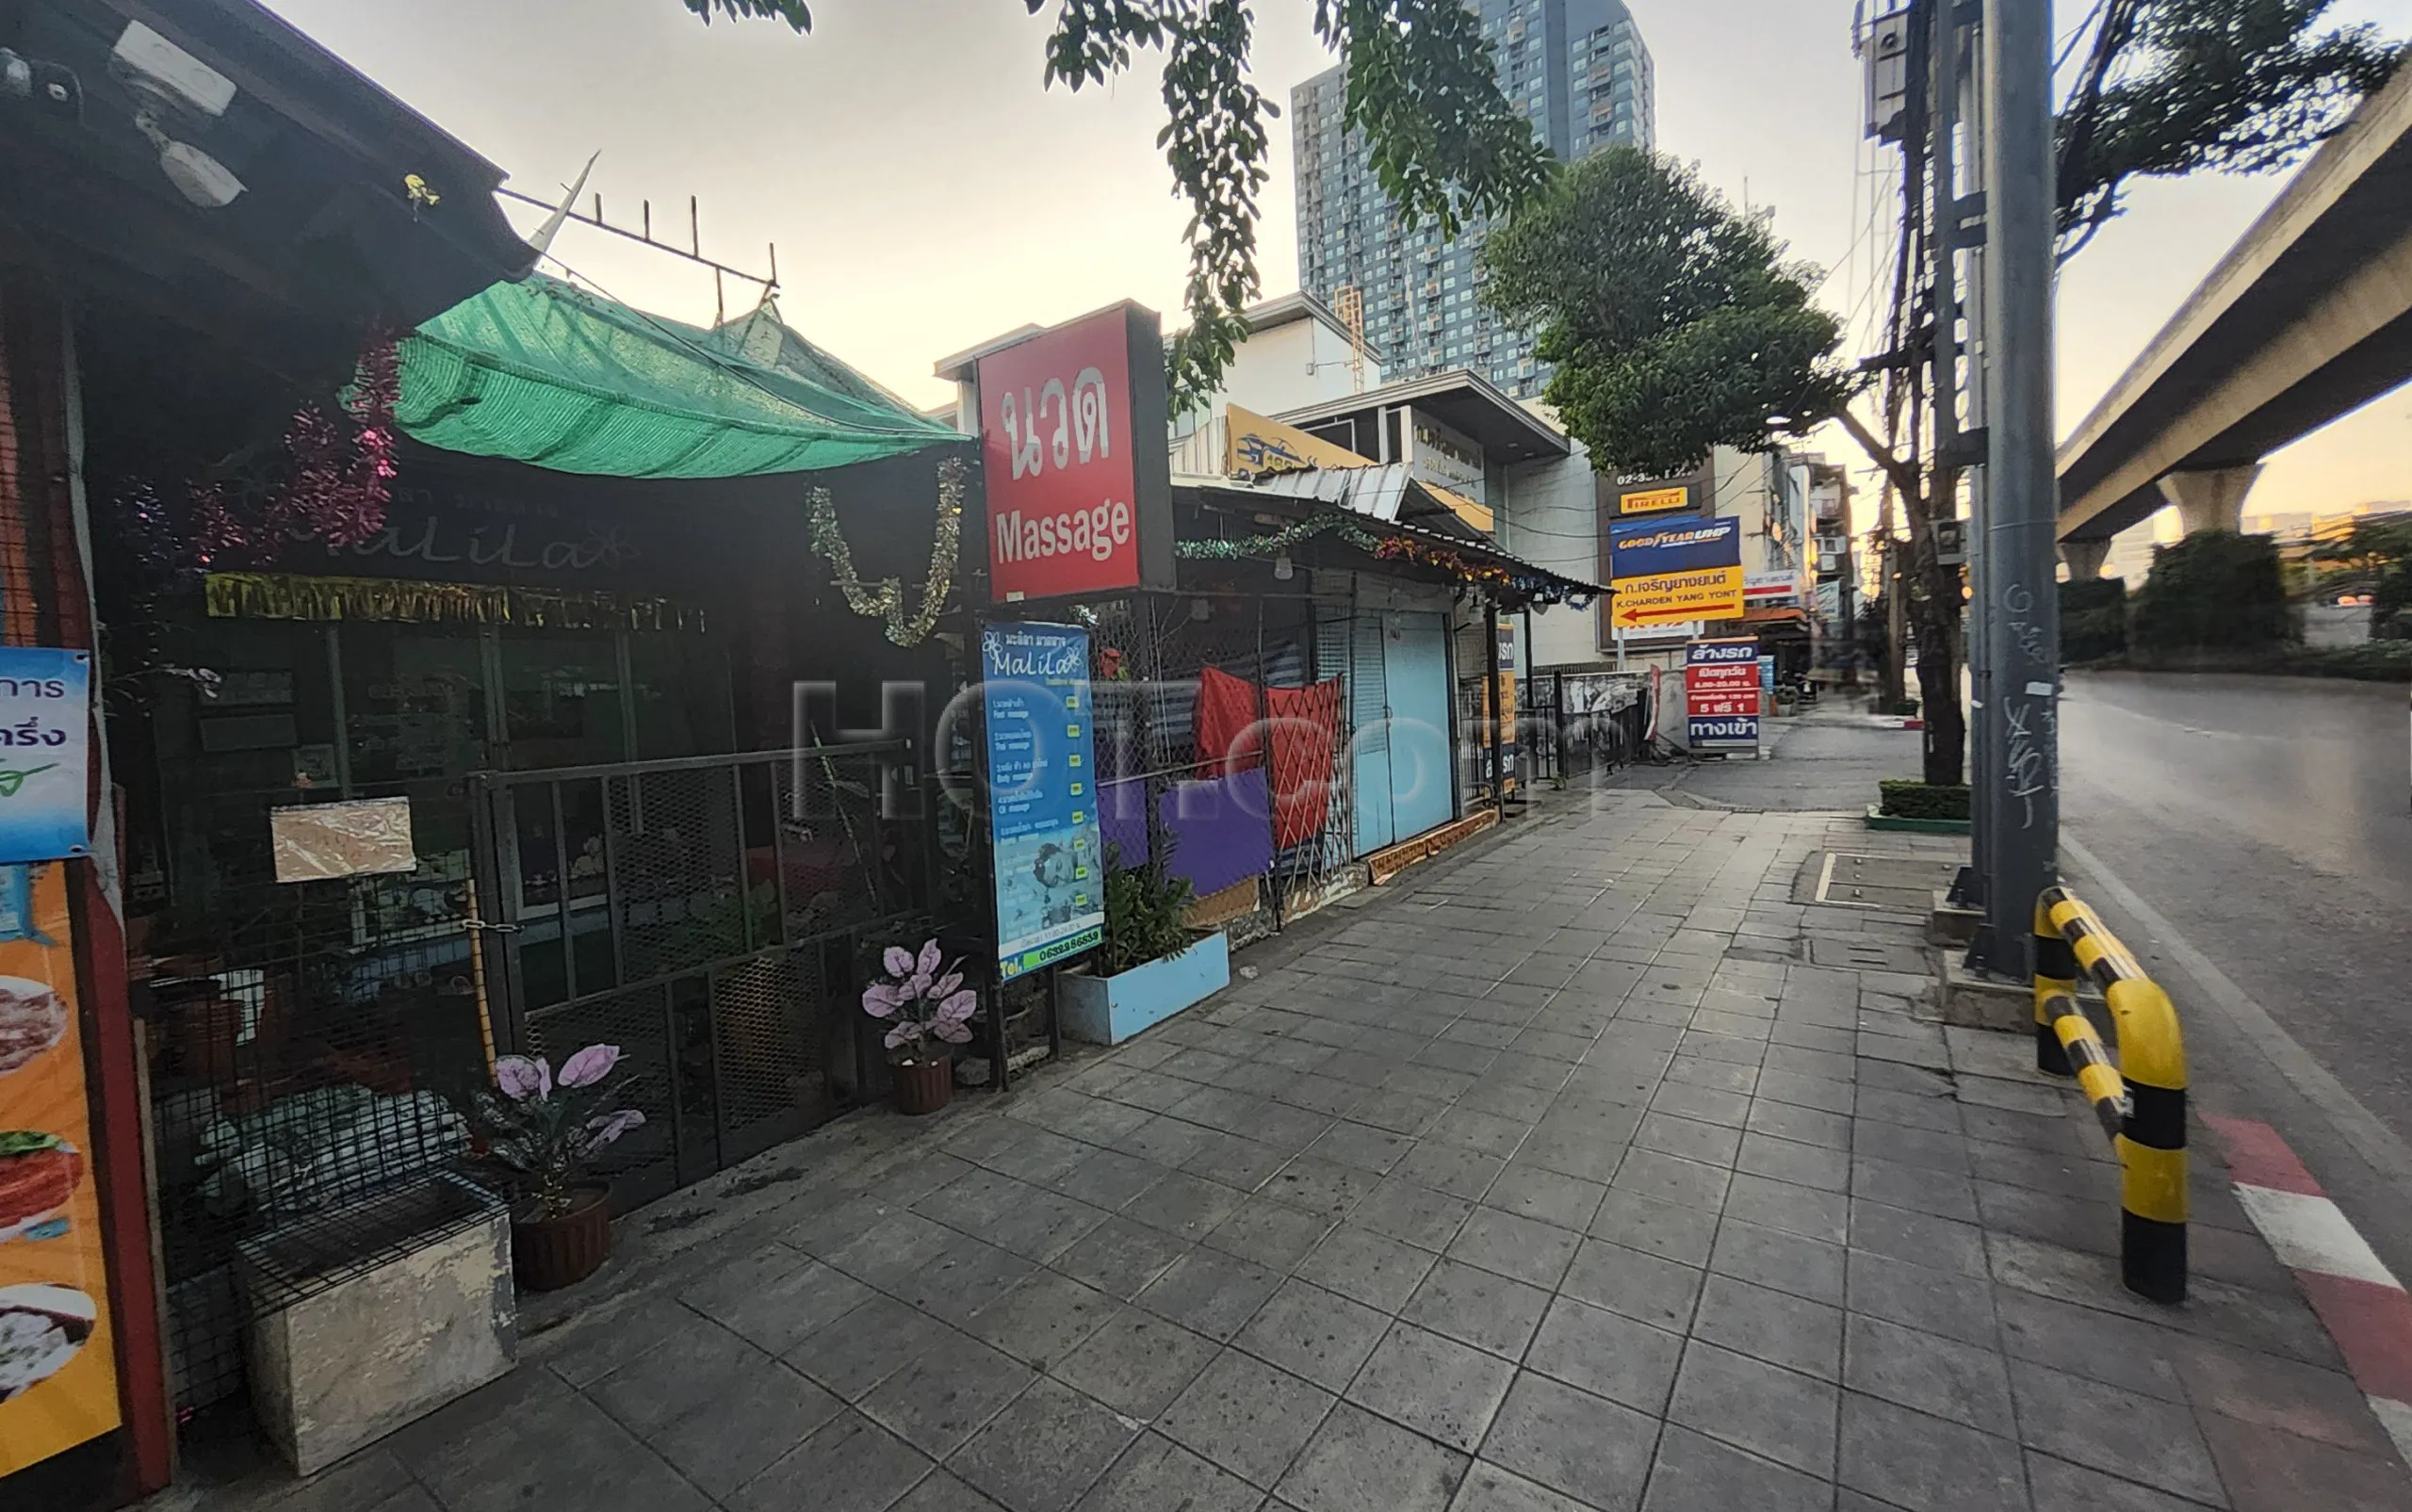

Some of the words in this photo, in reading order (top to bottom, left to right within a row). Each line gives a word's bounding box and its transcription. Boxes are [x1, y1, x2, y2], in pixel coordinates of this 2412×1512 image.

[1000, 366, 1110, 480] นวด
[1625, 490, 1683, 510] PIRELLI
[996, 496, 1131, 564] Massage
[1618, 530, 1695, 549] GOODYEAR
[1676, 593, 1704, 603] YANG
[1708, 588, 1737, 600] YONT
[1691, 643, 1752, 660] ล้างรถ
[1700, 704, 1709, 713] 5
[1713, 701, 1733, 713] ฟรี
[1736, 703, 1745, 713] 1
[1690, 717, 1758, 736] ทางเข้า
[1000, 956, 1022, 978] Tel.
